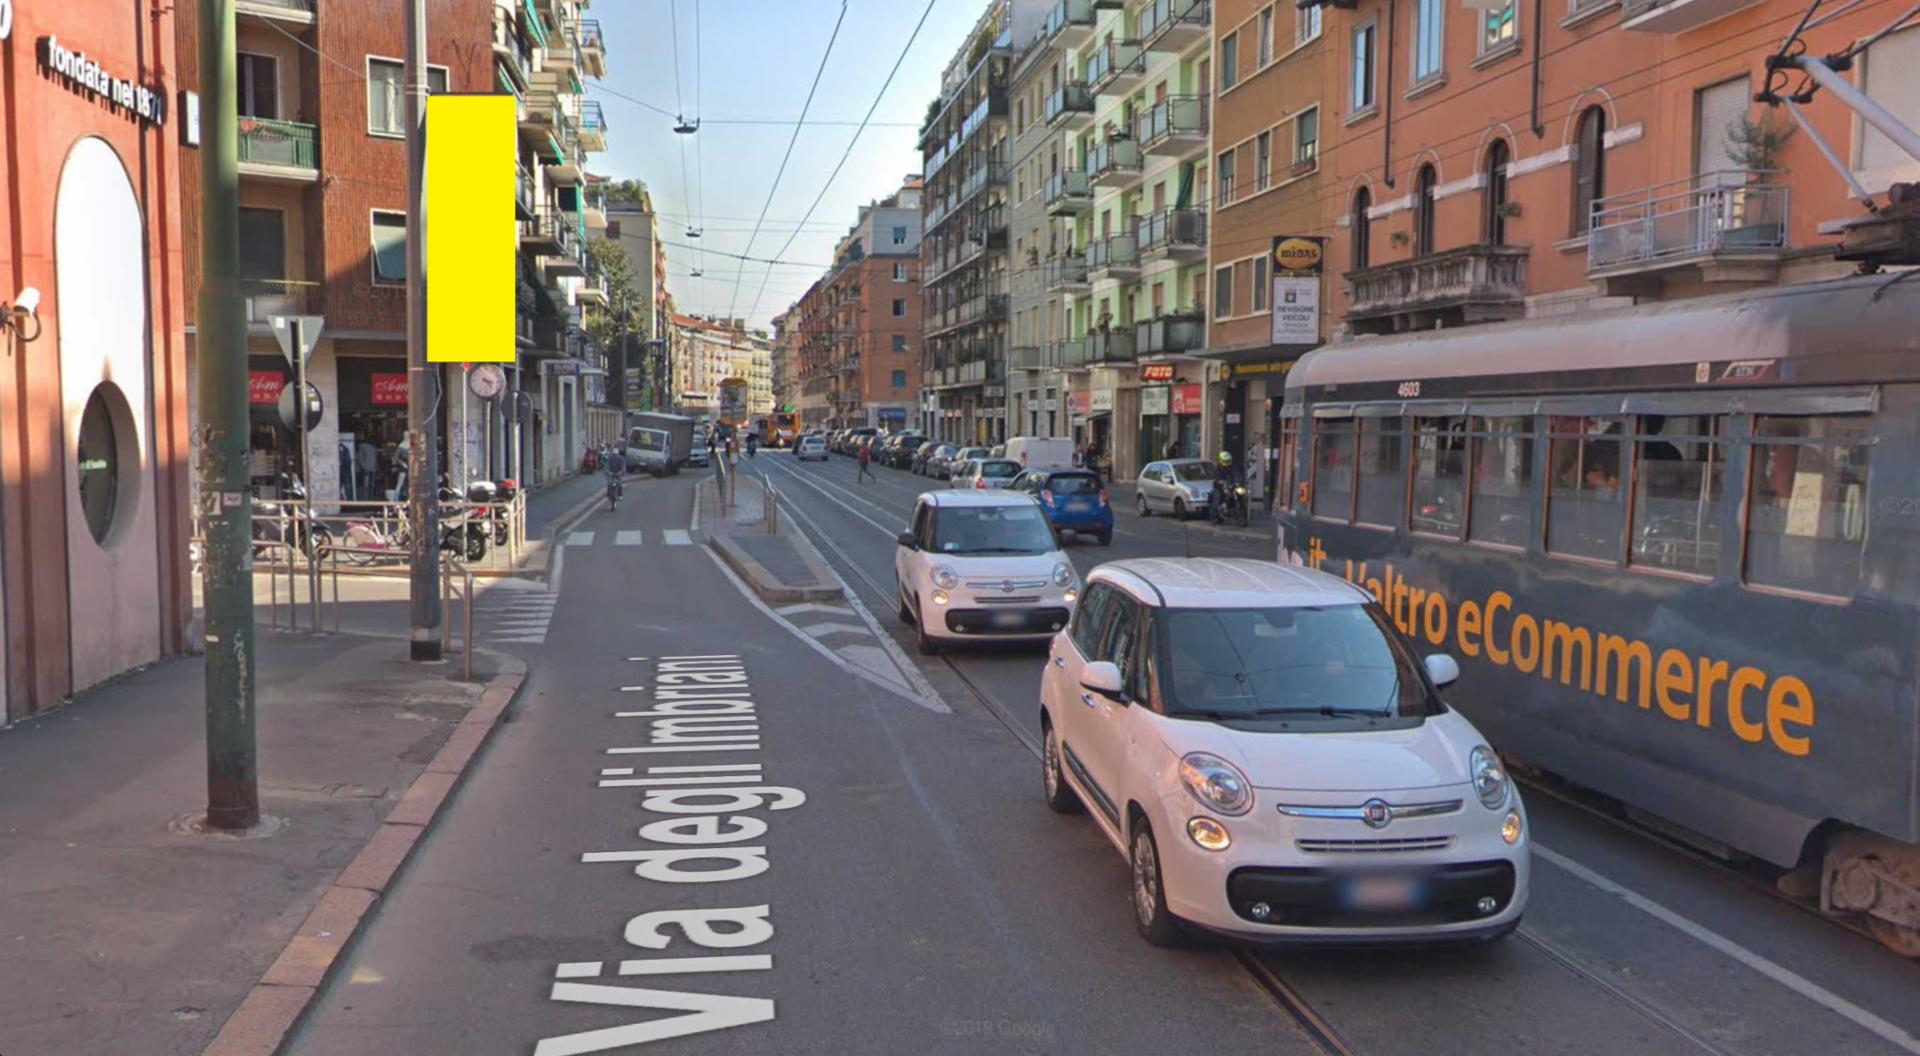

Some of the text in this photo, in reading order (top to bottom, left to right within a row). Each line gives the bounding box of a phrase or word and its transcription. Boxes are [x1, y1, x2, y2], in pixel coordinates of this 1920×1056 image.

[49, 34, 109, 97] fondata
[113, 78, 134, 109] nel
[1277, 305, 1315, 313] REVISIONE
[1282, 314, 1311, 322] VEICOLI
[1144, 365, 1174, 378] FOTO
[1398, 381, 1420, 397] 4603
[1456, 590, 1815, 756] eCommerce
